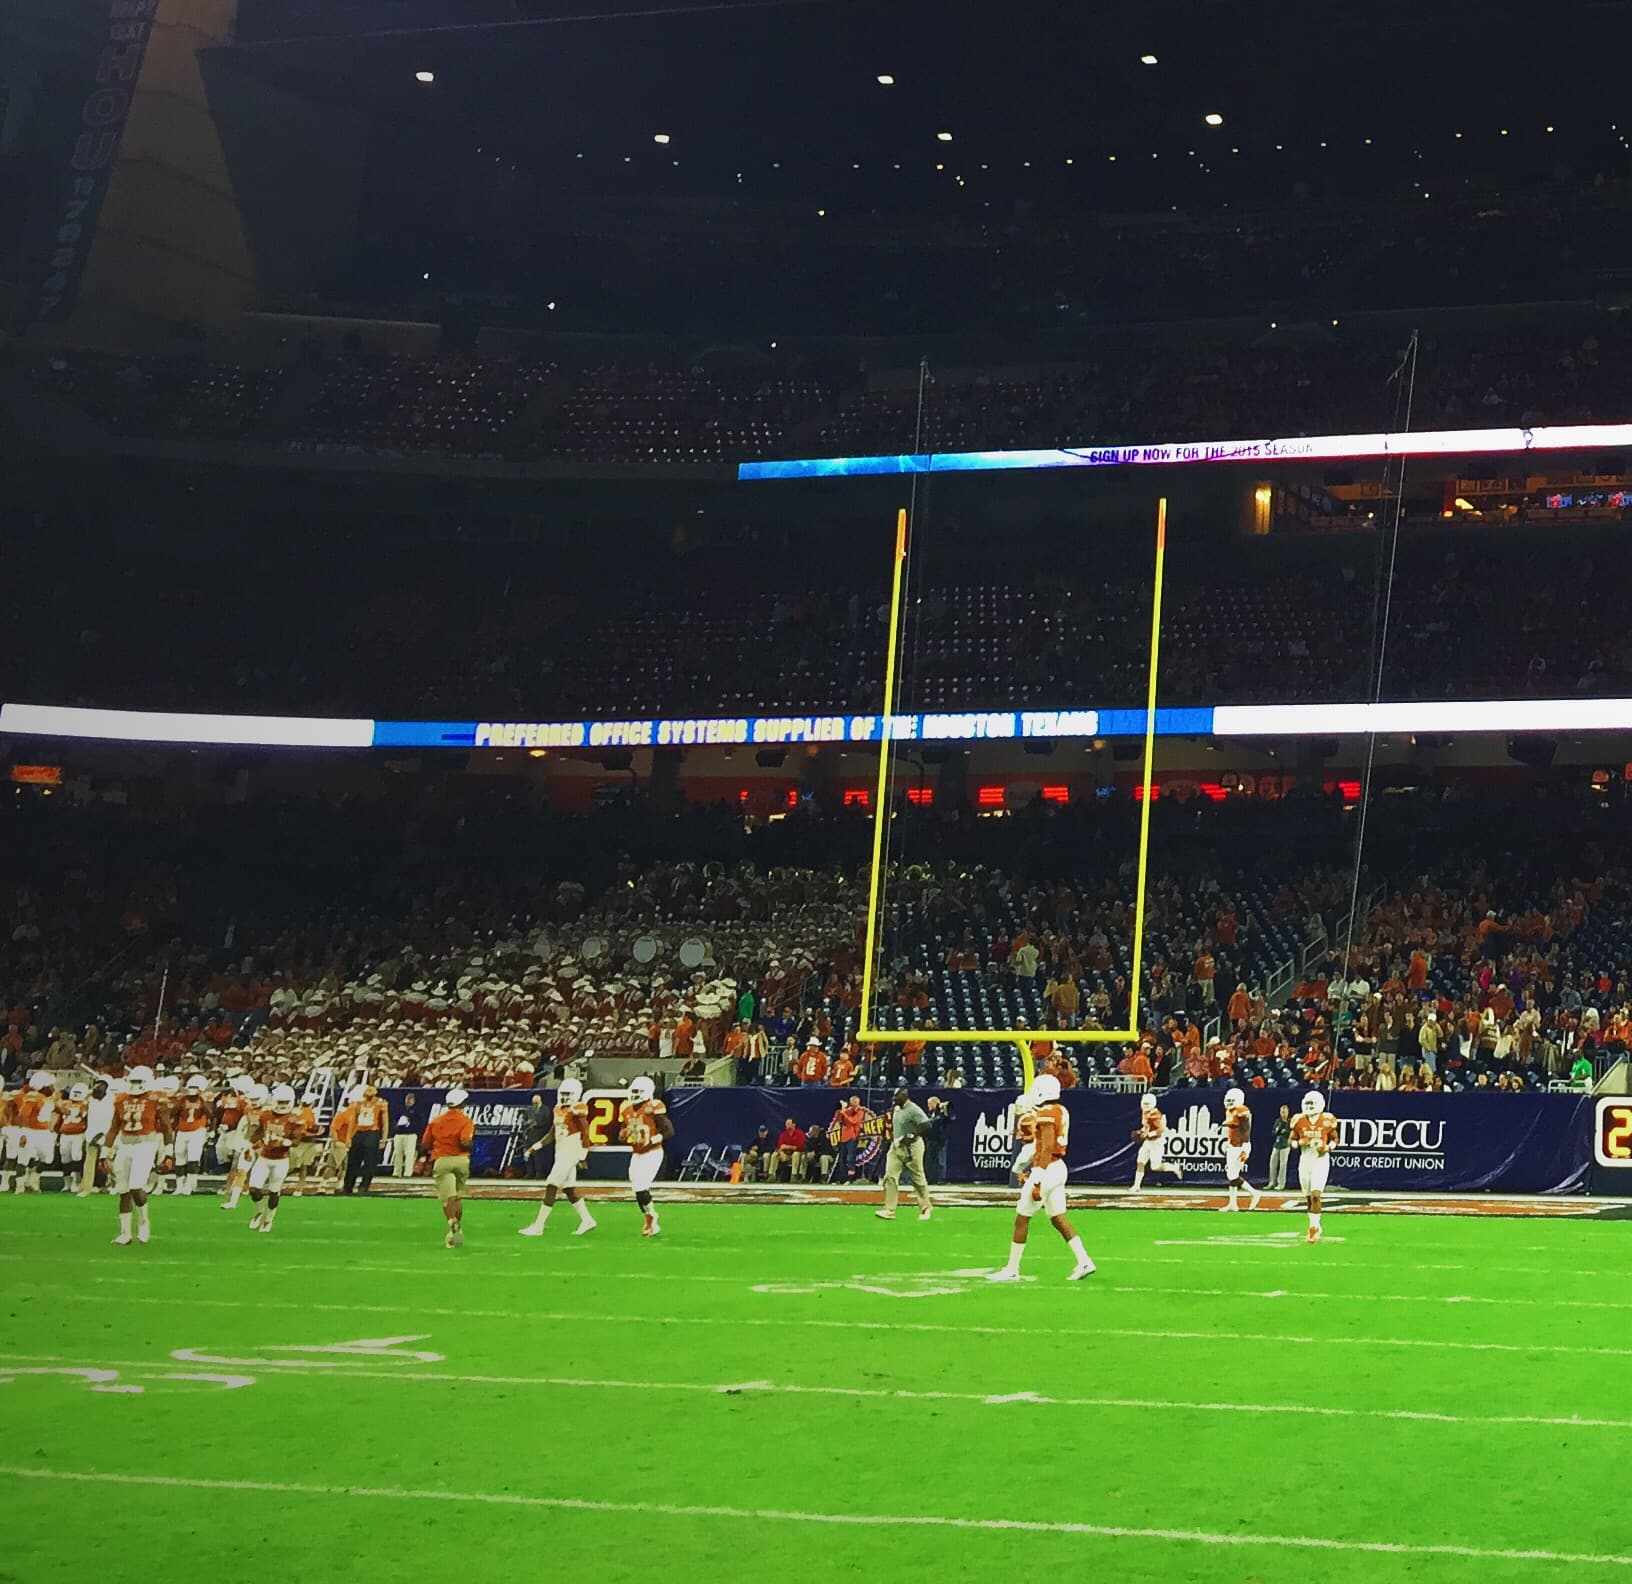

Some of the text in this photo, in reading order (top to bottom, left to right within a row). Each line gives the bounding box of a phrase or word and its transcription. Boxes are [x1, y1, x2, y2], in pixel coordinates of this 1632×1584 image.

[1090, 450, 1119, 463] SIGN
[1123, 449, 1139, 461] UP
[1143, 448, 1171, 461] NOW
[1175, 447, 1199, 459] FOR
[1204, 446, 1225, 458] THE
[1231, 445, 1260, 457] 2015
[589, 721, 652, 745] OFFICE
[657, 719, 748, 744] SYSTEMS
[753, 717, 845, 743] SUPPLIER
[850, 716, 875, 741] OF
[1021, 710, 1099, 737] TEXANS
[1336, 1118, 1447, 1149] TDECU
[1331, 1156, 1445, 1170] YOUR CREDIT UNION
